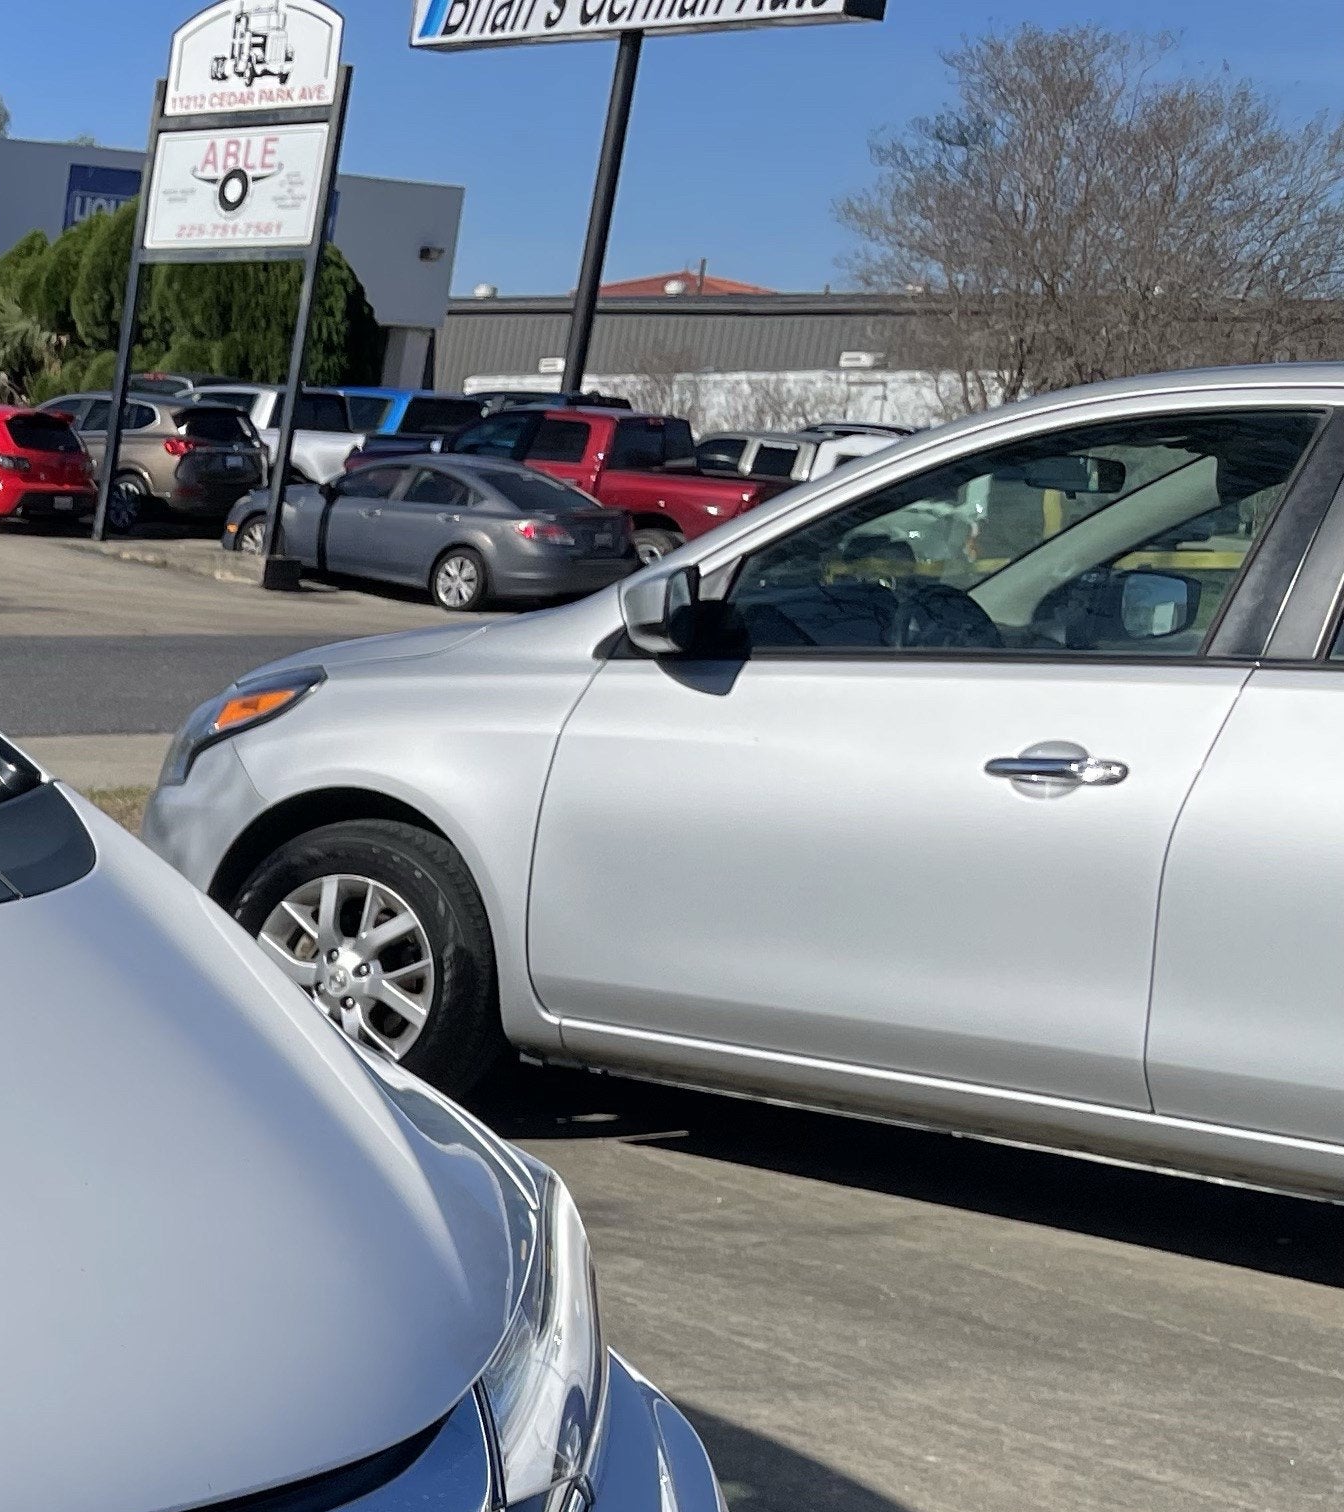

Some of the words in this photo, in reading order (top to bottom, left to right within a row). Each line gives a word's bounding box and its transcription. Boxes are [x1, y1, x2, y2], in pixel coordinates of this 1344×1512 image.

[441, 0, 567, 36] Brians
[209, 90, 255, 107] CEDAR
[258, 87, 294, 105] PARK
[199, 136, 279, 173] ABLE
